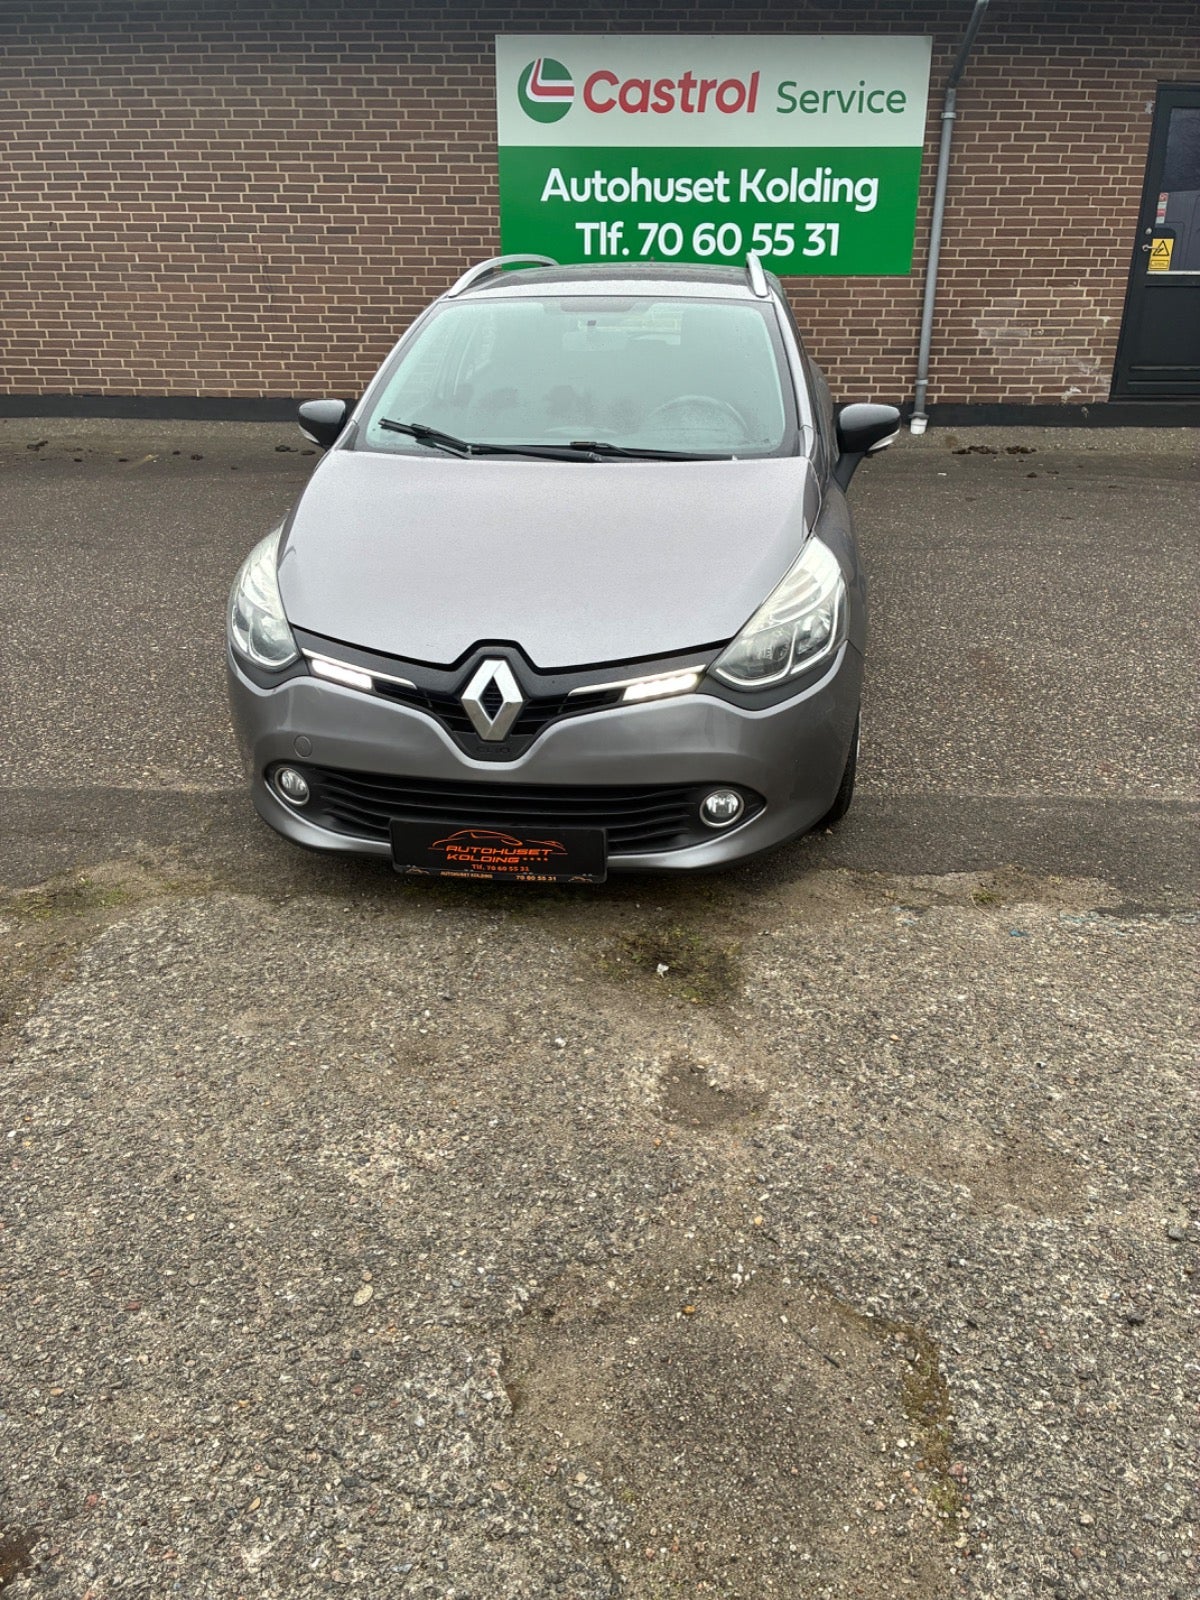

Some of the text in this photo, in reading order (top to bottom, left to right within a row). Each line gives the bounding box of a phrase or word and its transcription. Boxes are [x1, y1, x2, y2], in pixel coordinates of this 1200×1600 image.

[583, 70, 907, 114] Castrol Service
[540, 167, 879, 213] Autohuset Kolding
[575, 222, 840, 256] Tlf. 70 60 55 31
[446, 845, 553, 855] AUTOHUSET
[446, 854, 520, 863] KOLDING
